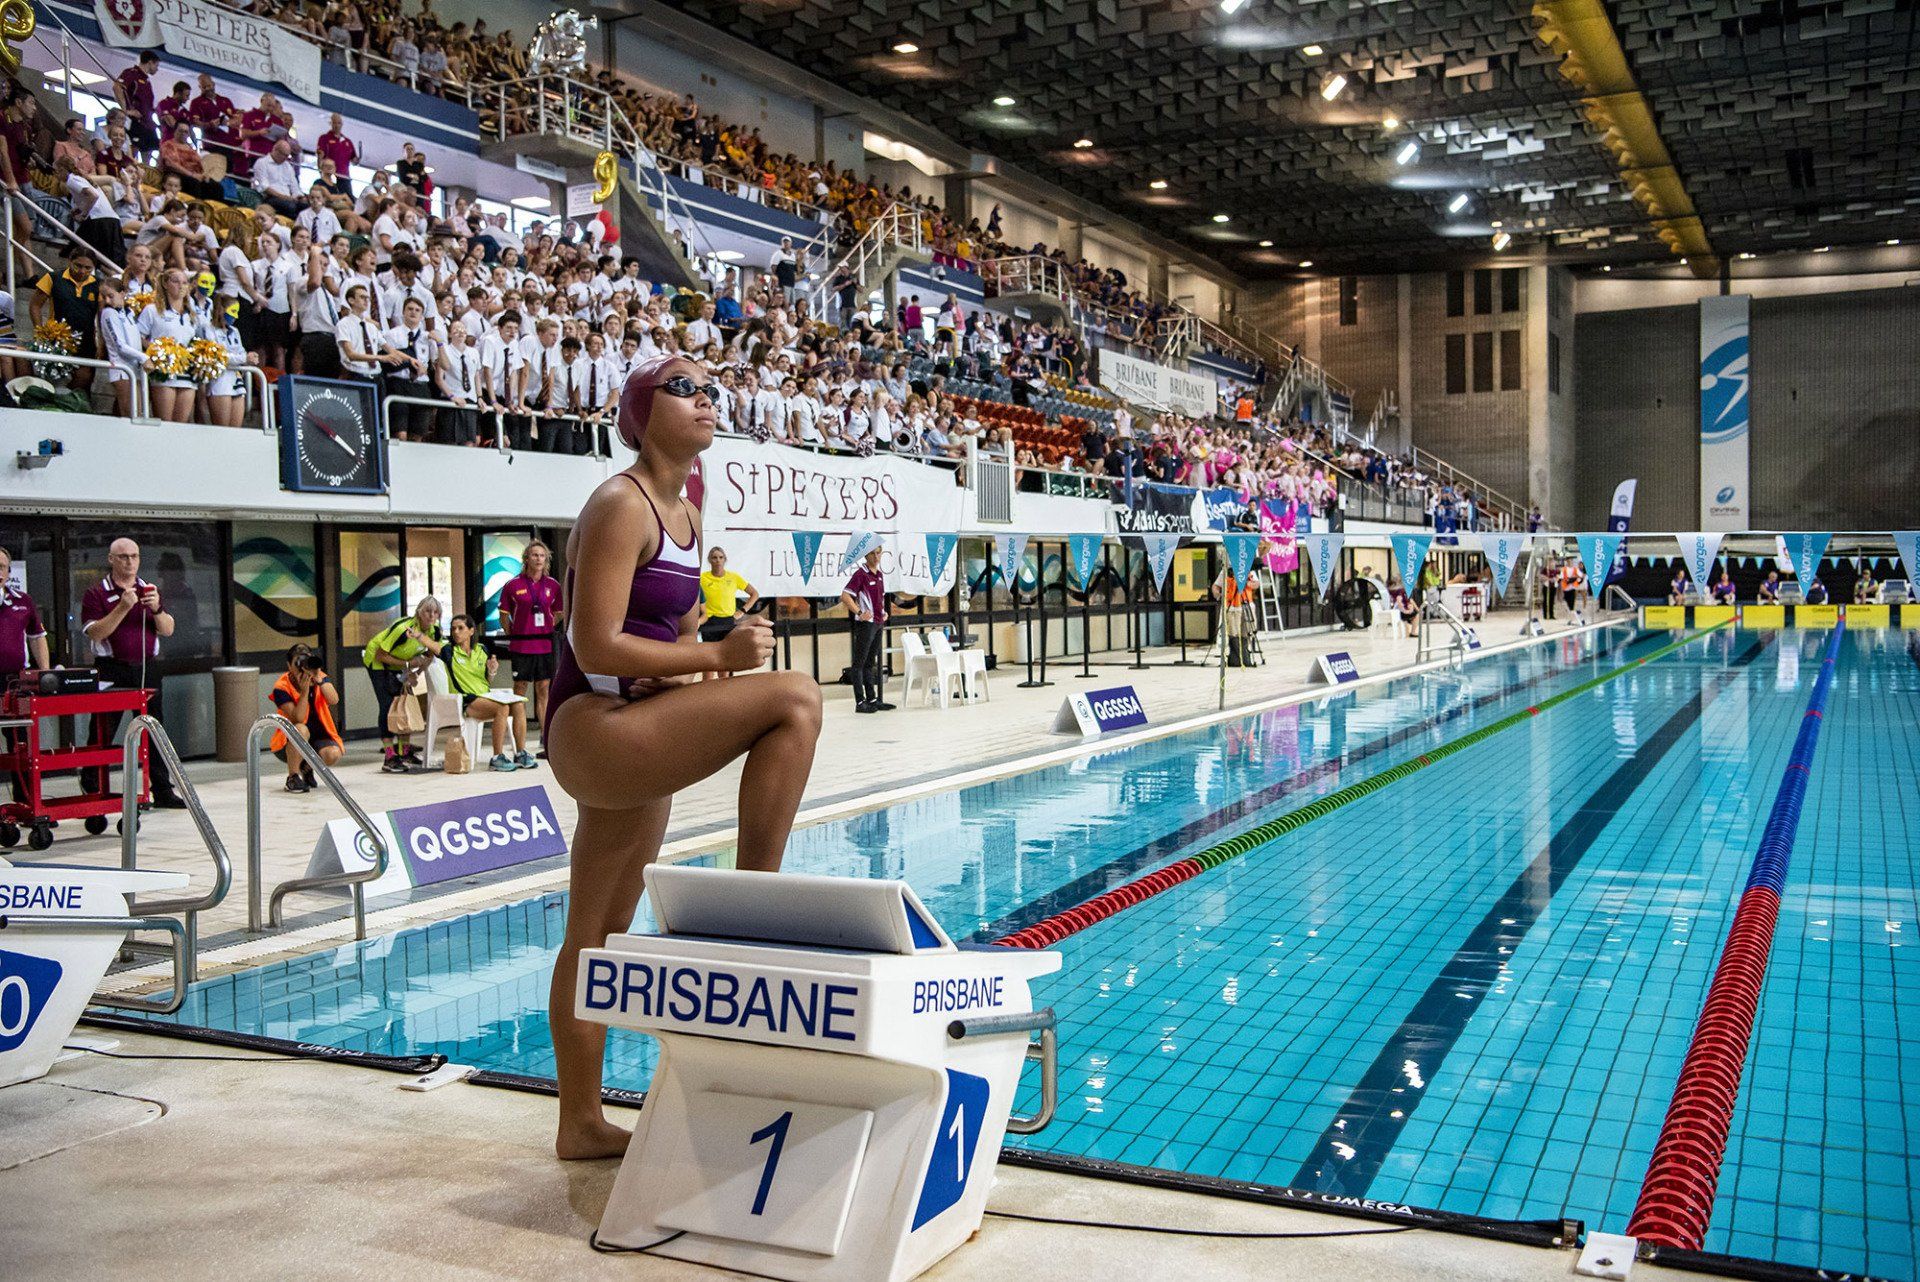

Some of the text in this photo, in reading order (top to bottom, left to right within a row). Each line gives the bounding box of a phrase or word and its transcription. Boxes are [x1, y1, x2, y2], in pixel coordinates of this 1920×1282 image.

[177, 0, 272, 50] PETERS
[360, 434, 371, 445] 15
[329, 475, 341, 486] 30
[765, 464, 899, 520] PETERS
[1094, 695, 1142, 721] QGSSSA
[409, 805, 556, 862] QGSSSA
[585, 958, 859, 1041] BRISBANE
[912, 976, 1004, 1014] BRISBANE
[749, 1111, 793, 1215] 1
[949, 1102, 966, 1182] 1
[1321, 1194, 1414, 1216] OMEGA
